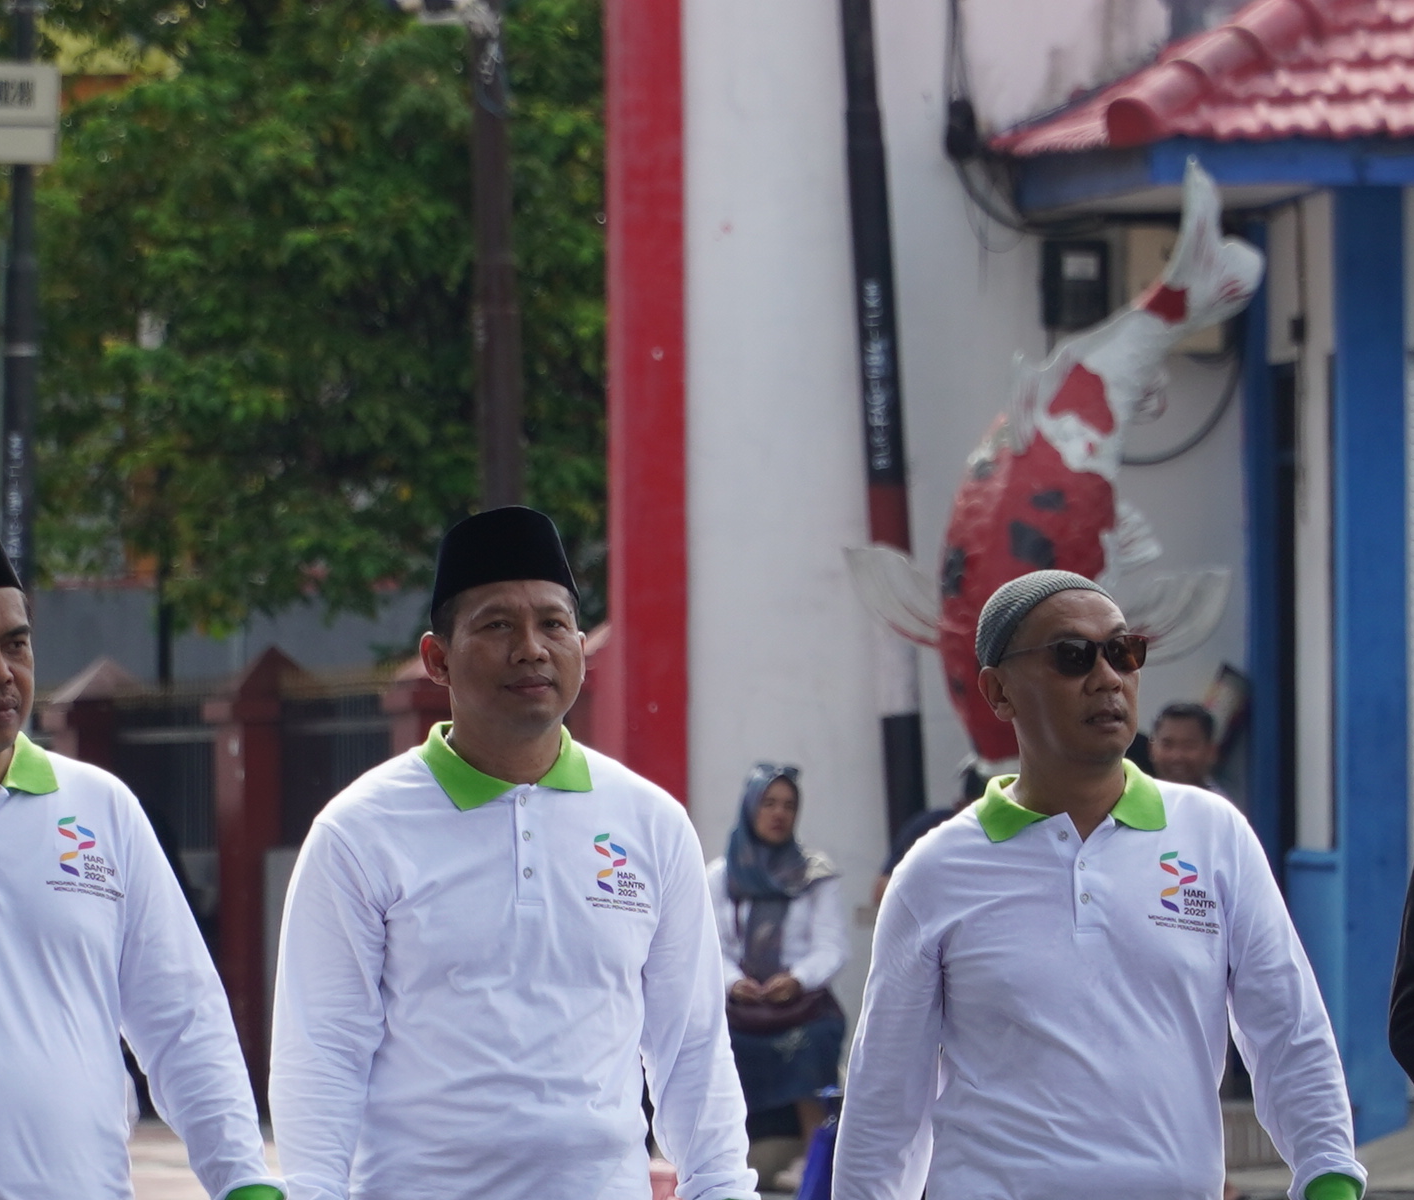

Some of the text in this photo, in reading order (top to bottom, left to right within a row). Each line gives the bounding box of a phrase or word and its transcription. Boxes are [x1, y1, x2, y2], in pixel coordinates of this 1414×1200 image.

[82, 854, 105, 864] HARI
[83, 863, 115, 876] SANTRI
[84, 872, 106, 882] 2025
[616, 871, 636, 880] HARI
[617, 880, 645, 890] SANTRI
[617, 889, 637, 898] 2025
[1183, 889, 1207, 899] HARI
[1183, 898, 1217, 909] SANTRI
[1183, 908, 1207, 918] 2025
